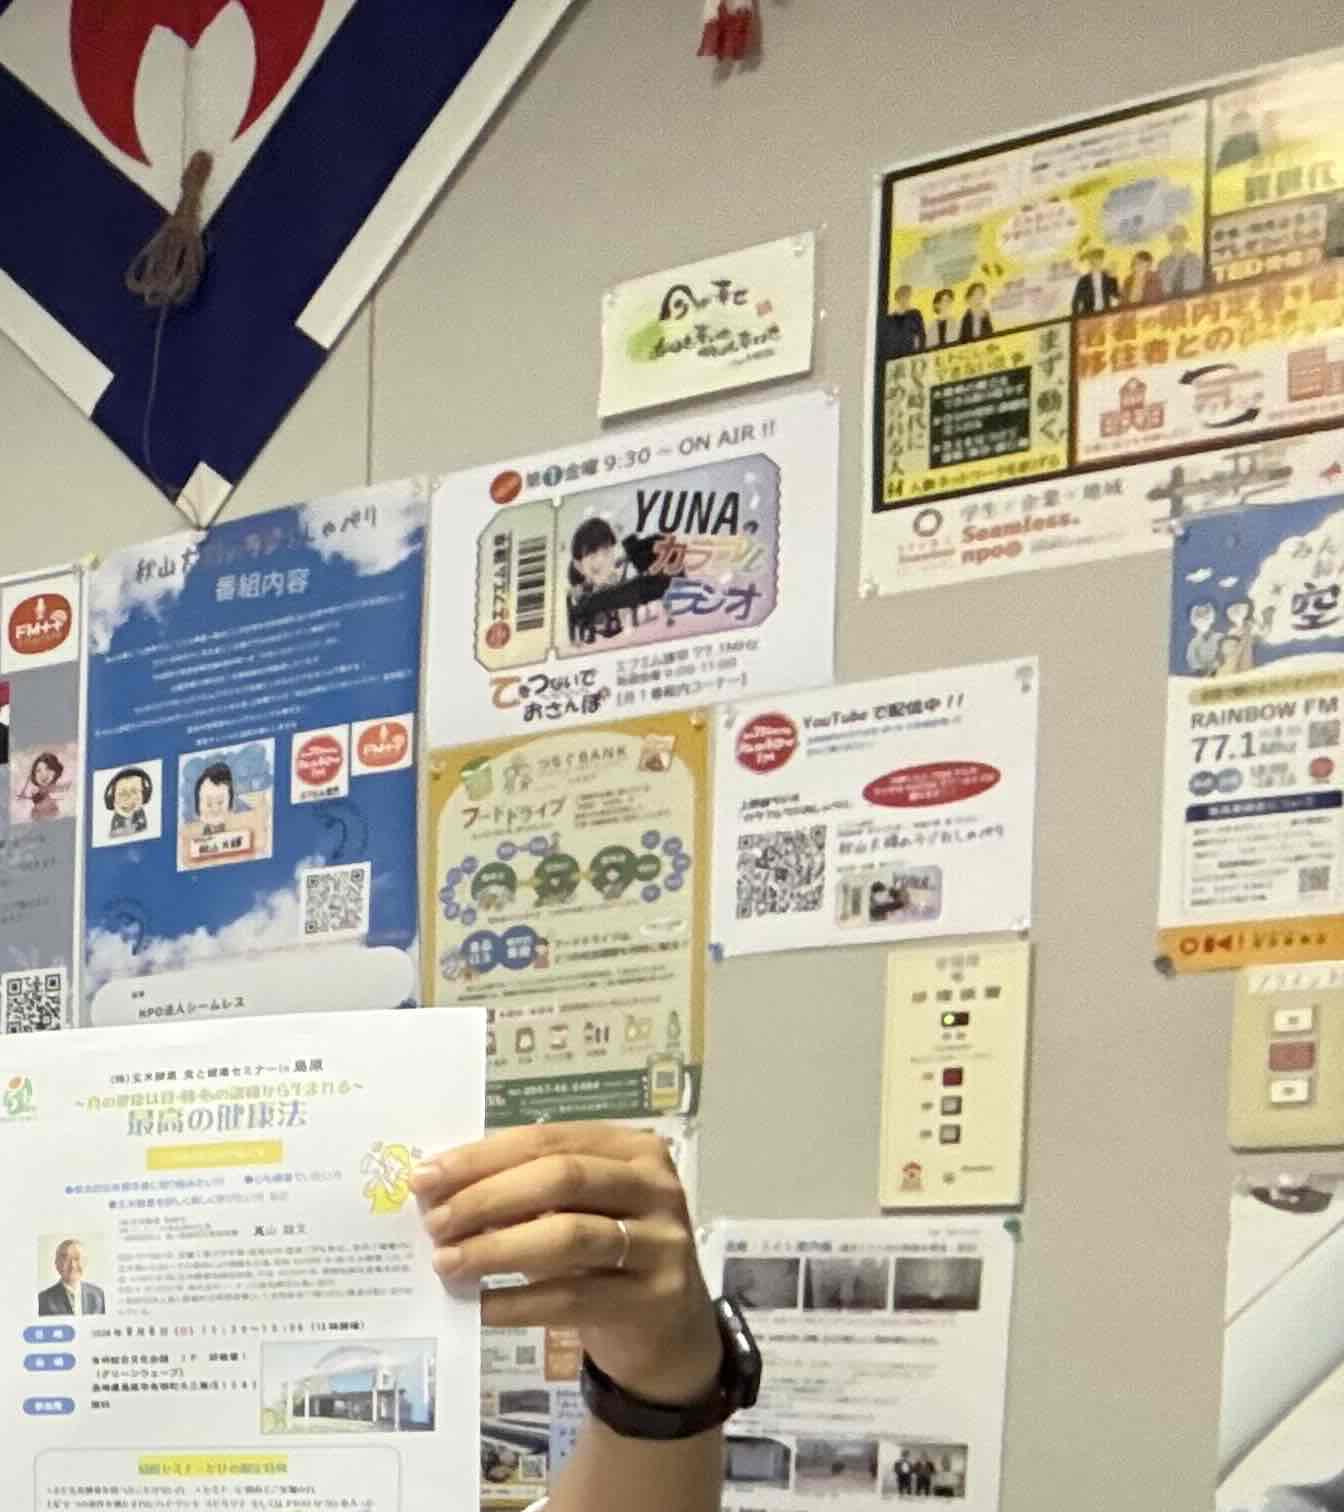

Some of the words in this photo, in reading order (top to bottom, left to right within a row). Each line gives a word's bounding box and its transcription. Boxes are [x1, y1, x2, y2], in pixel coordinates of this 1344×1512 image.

[679, 436, 711, 456] ON
[718, 426, 756, 446] AIR
[215, 567, 311, 602] 番組内容
[1191, 700, 1297, 730] RAINBOW
[1190, 731, 1257, 764] 77.1
[126, 1099, 309, 1137] 最高の健康法
